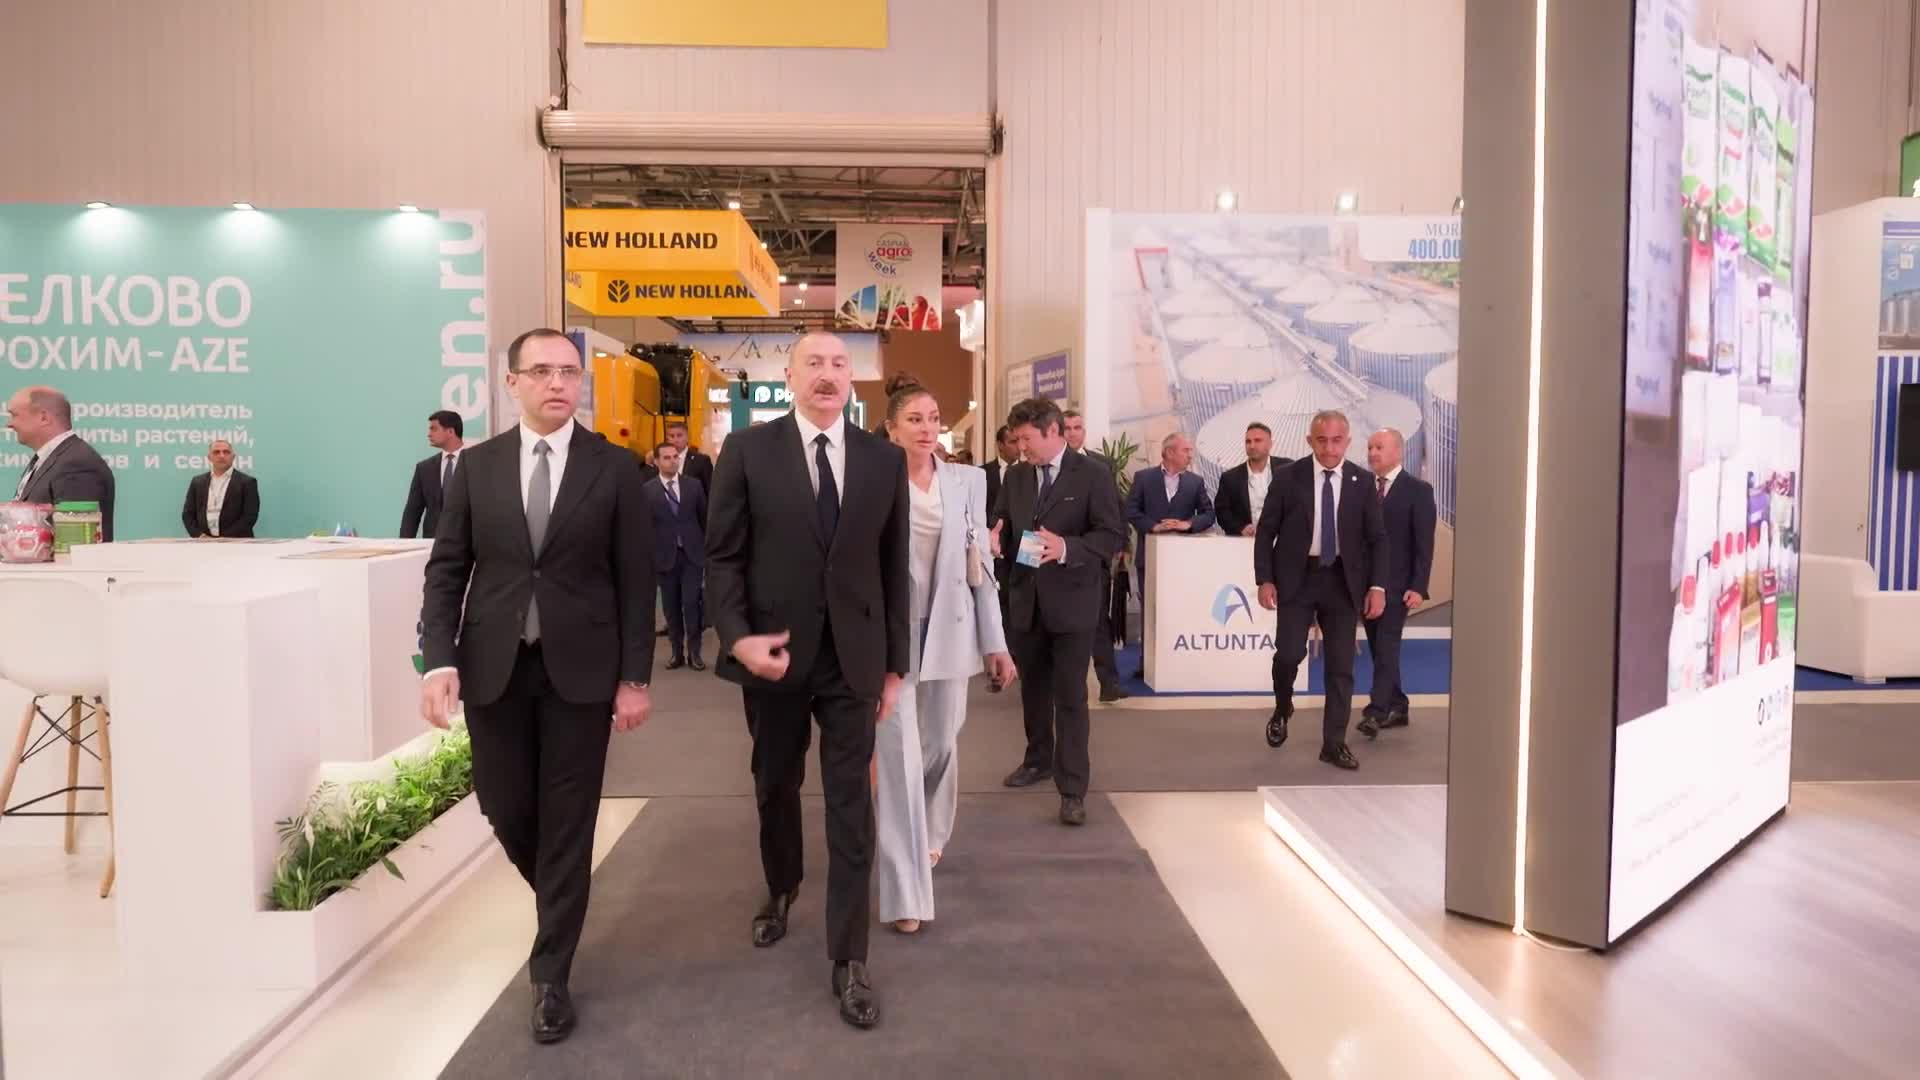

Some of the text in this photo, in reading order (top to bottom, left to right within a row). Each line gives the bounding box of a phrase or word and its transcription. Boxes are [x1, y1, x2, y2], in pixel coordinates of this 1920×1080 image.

[615, 231, 718, 249] HOLLAND
[1425, 223, 1460, 237] MOR
[1408, 239, 1461, 260] 400.00
[868, 251, 897, 275] week
[0, 273, 252, 328] ЕЛКОВО
[635, 284, 675, 299] NEW
[440, 208, 488, 448] en.ru
[0, 336, 249, 373] ОХИМ-AZE
[73, 402, 253, 421] роизводитель
[135, 425, 255, 448] растений,
[144, 454, 160, 469] и
[175, 454, 253, 469] сен
[1173, 633, 1275, 651] ALTUNTA
